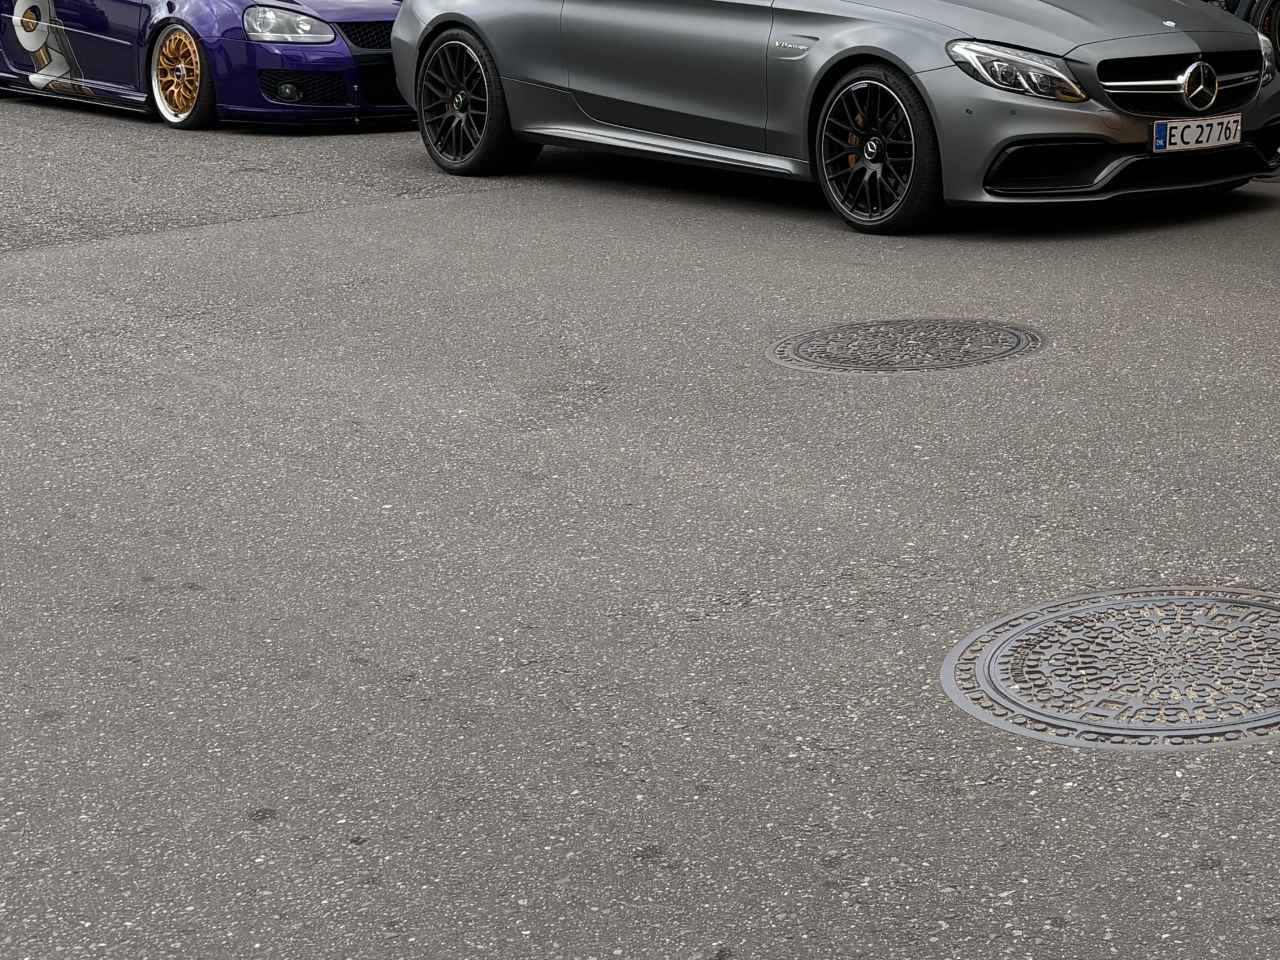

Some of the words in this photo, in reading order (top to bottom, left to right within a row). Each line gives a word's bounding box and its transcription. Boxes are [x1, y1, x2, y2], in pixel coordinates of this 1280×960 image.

[1168, 125, 1191, 146] EC
[1195, 123, 1214, 144] 27
[1217, 119, 1240, 142] 767
